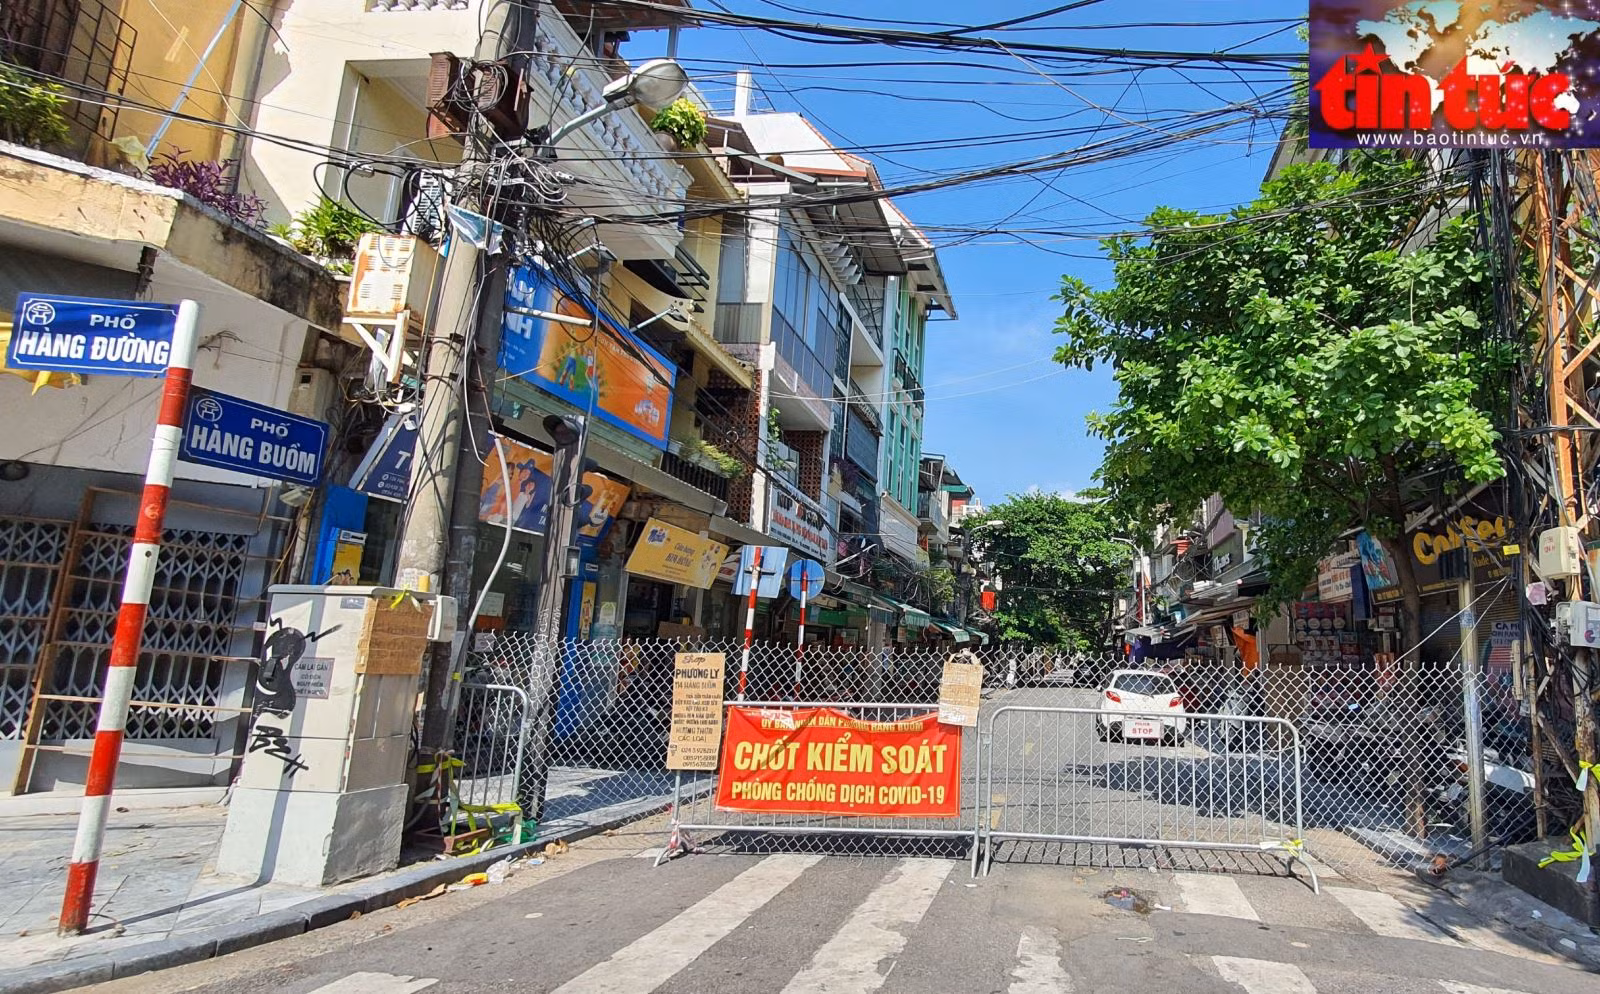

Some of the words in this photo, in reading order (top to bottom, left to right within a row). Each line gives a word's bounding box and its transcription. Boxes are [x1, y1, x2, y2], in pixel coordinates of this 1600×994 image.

[90, 313, 139, 330] PHỐ
[18, 327, 87, 359] HÀNG
[90, 333, 171, 365] ĐƯỜNG
[251, 417, 291, 438] PHỐ
[191, 424, 254, 460] HÀNG
[258, 441, 316, 475] BUỒM
[733, 735, 800, 771] CHỐT
[806, 732, 873, 772] KIỂM
[881, 739, 947, 774] SOÁT
[731, 777, 782, 801] PHÒNG
[786, 777, 835, 803] CHỐNG
[840, 784, 875, 807] DỊCH
[878, 785, 945, 805] COVID-19
